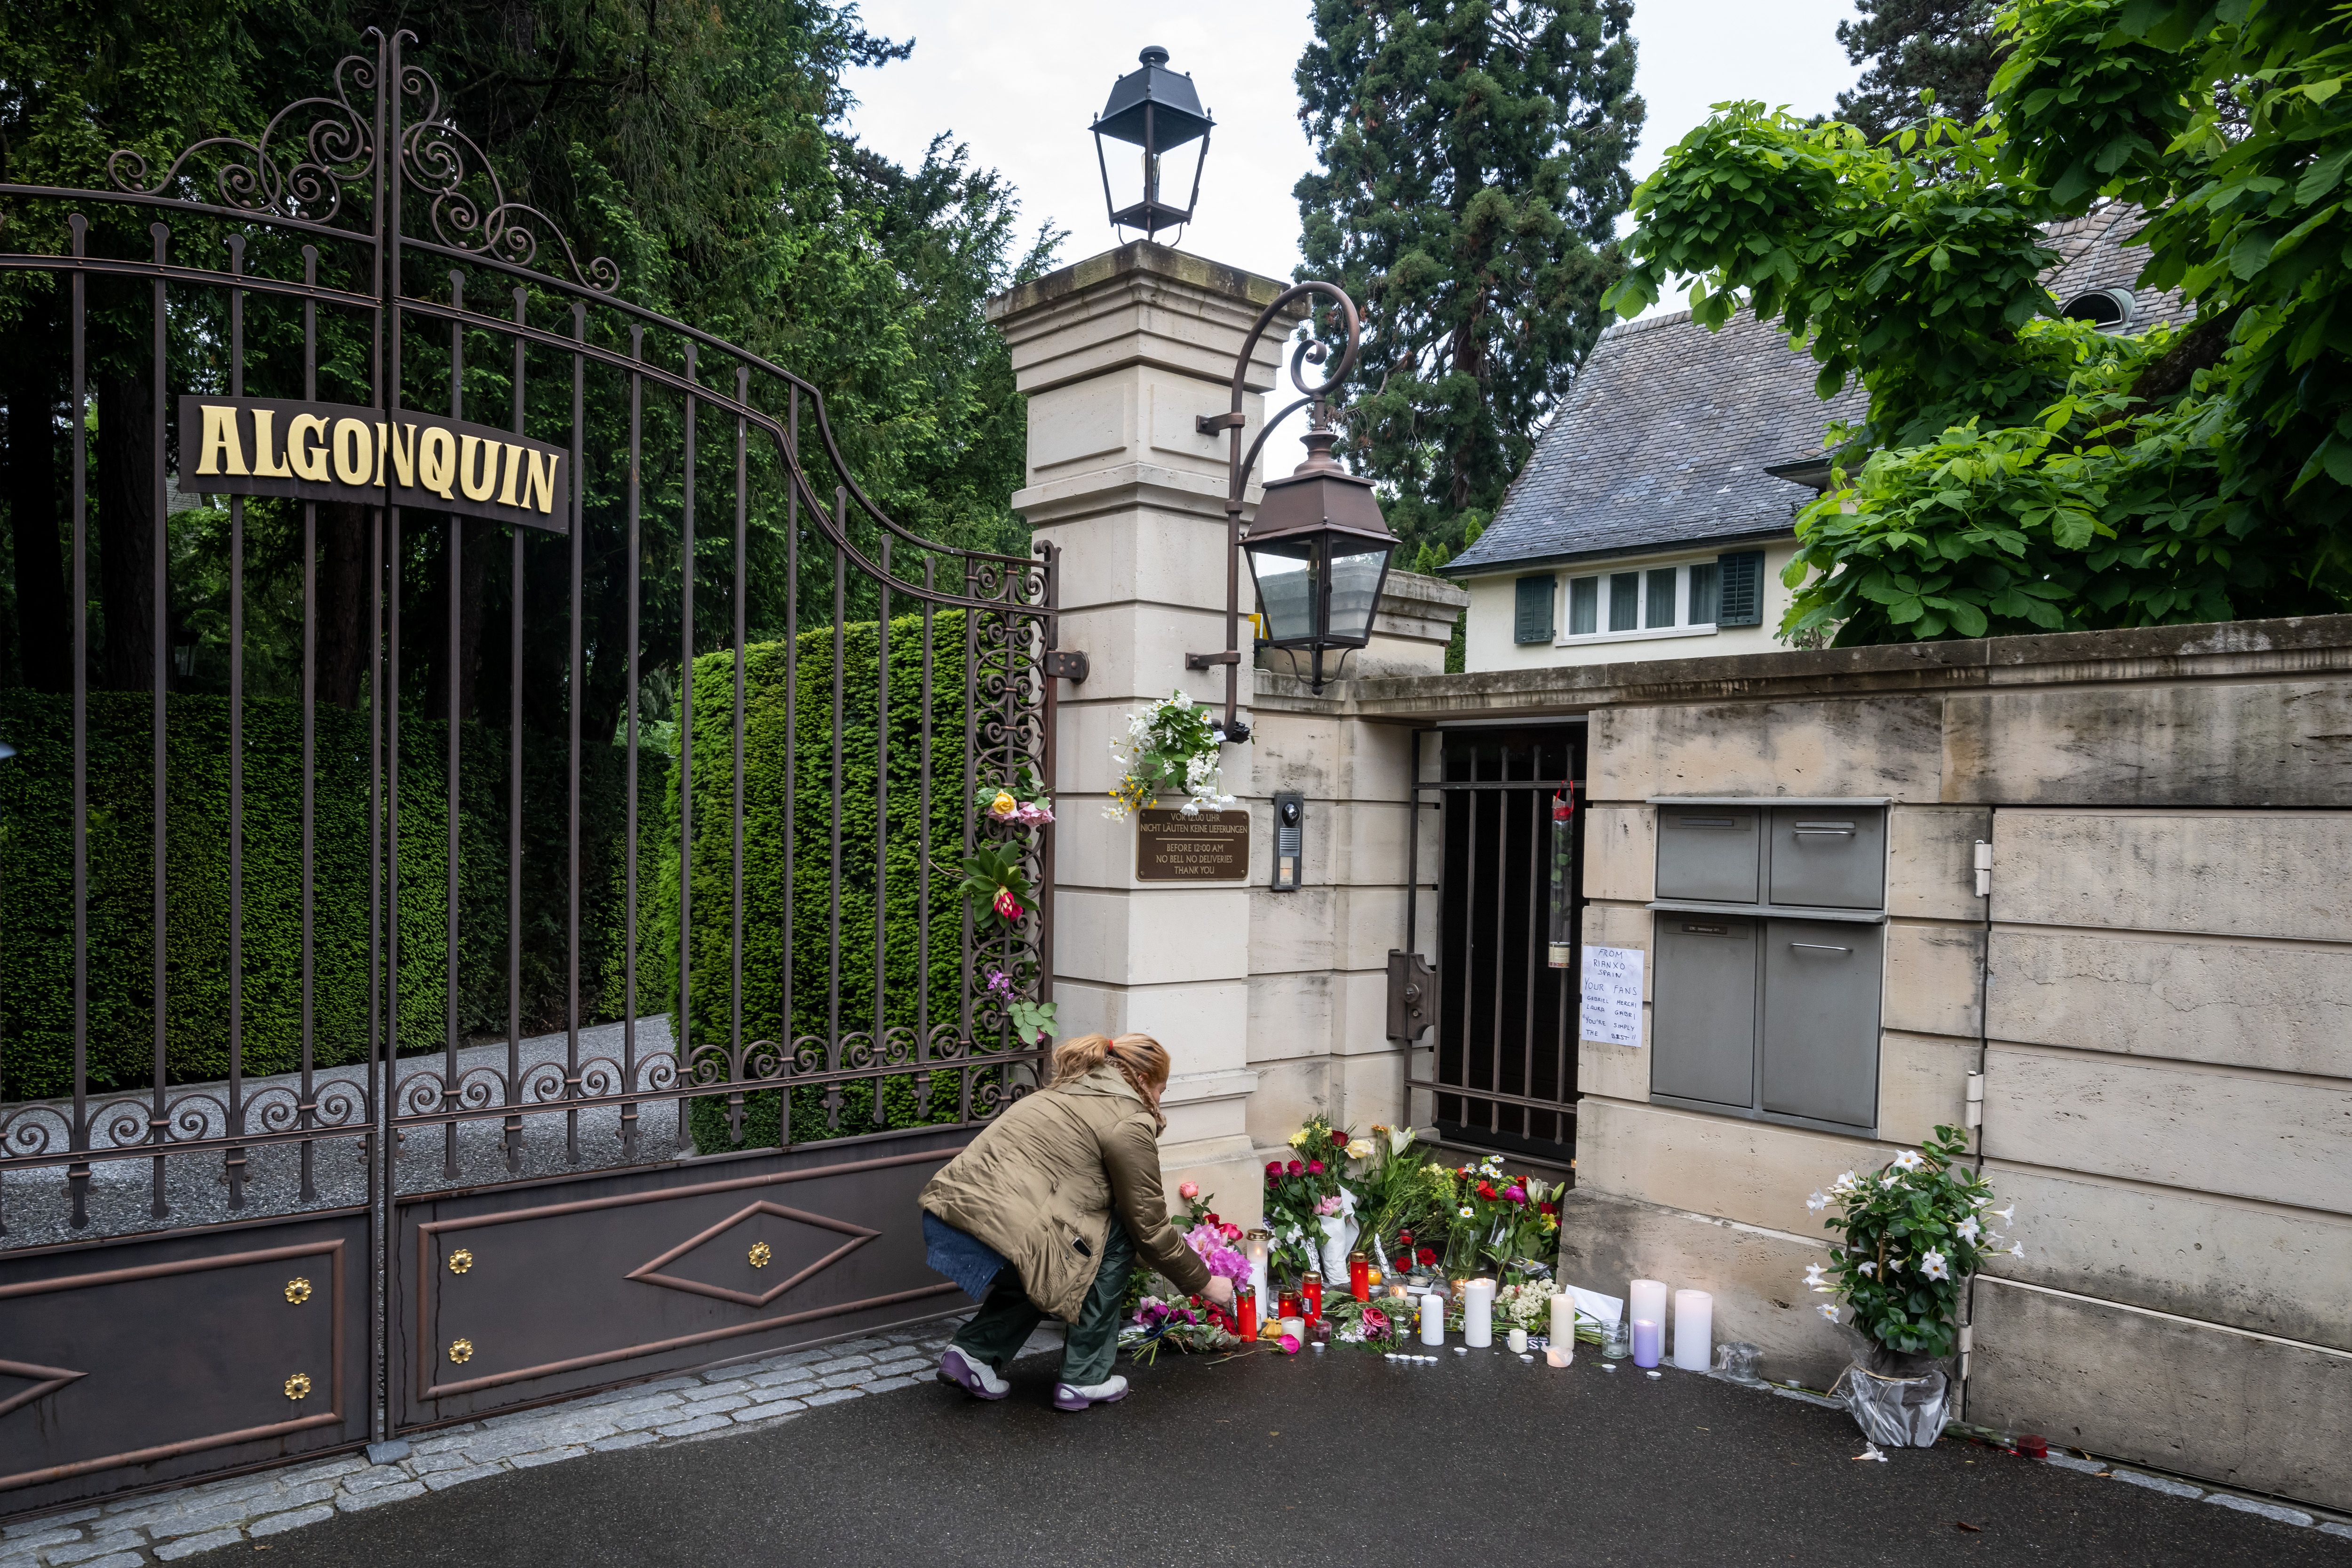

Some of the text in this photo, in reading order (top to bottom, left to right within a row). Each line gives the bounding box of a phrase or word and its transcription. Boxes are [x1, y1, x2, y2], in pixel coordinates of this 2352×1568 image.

[195, 405, 559, 514] ALGONQUIN
[1163, 822, 1188, 832] LÄUTEN
[1598, 949, 1622, 959] FROM
[1594, 959, 1625, 970] RIANXO
[1597, 970, 1622, 978] SPAIN
[1585, 977, 1637, 995] YOUR FANS
[1615, 1011, 1635, 1019] GABRI
[1613, 1023, 1635, 1031] SIMPLY
